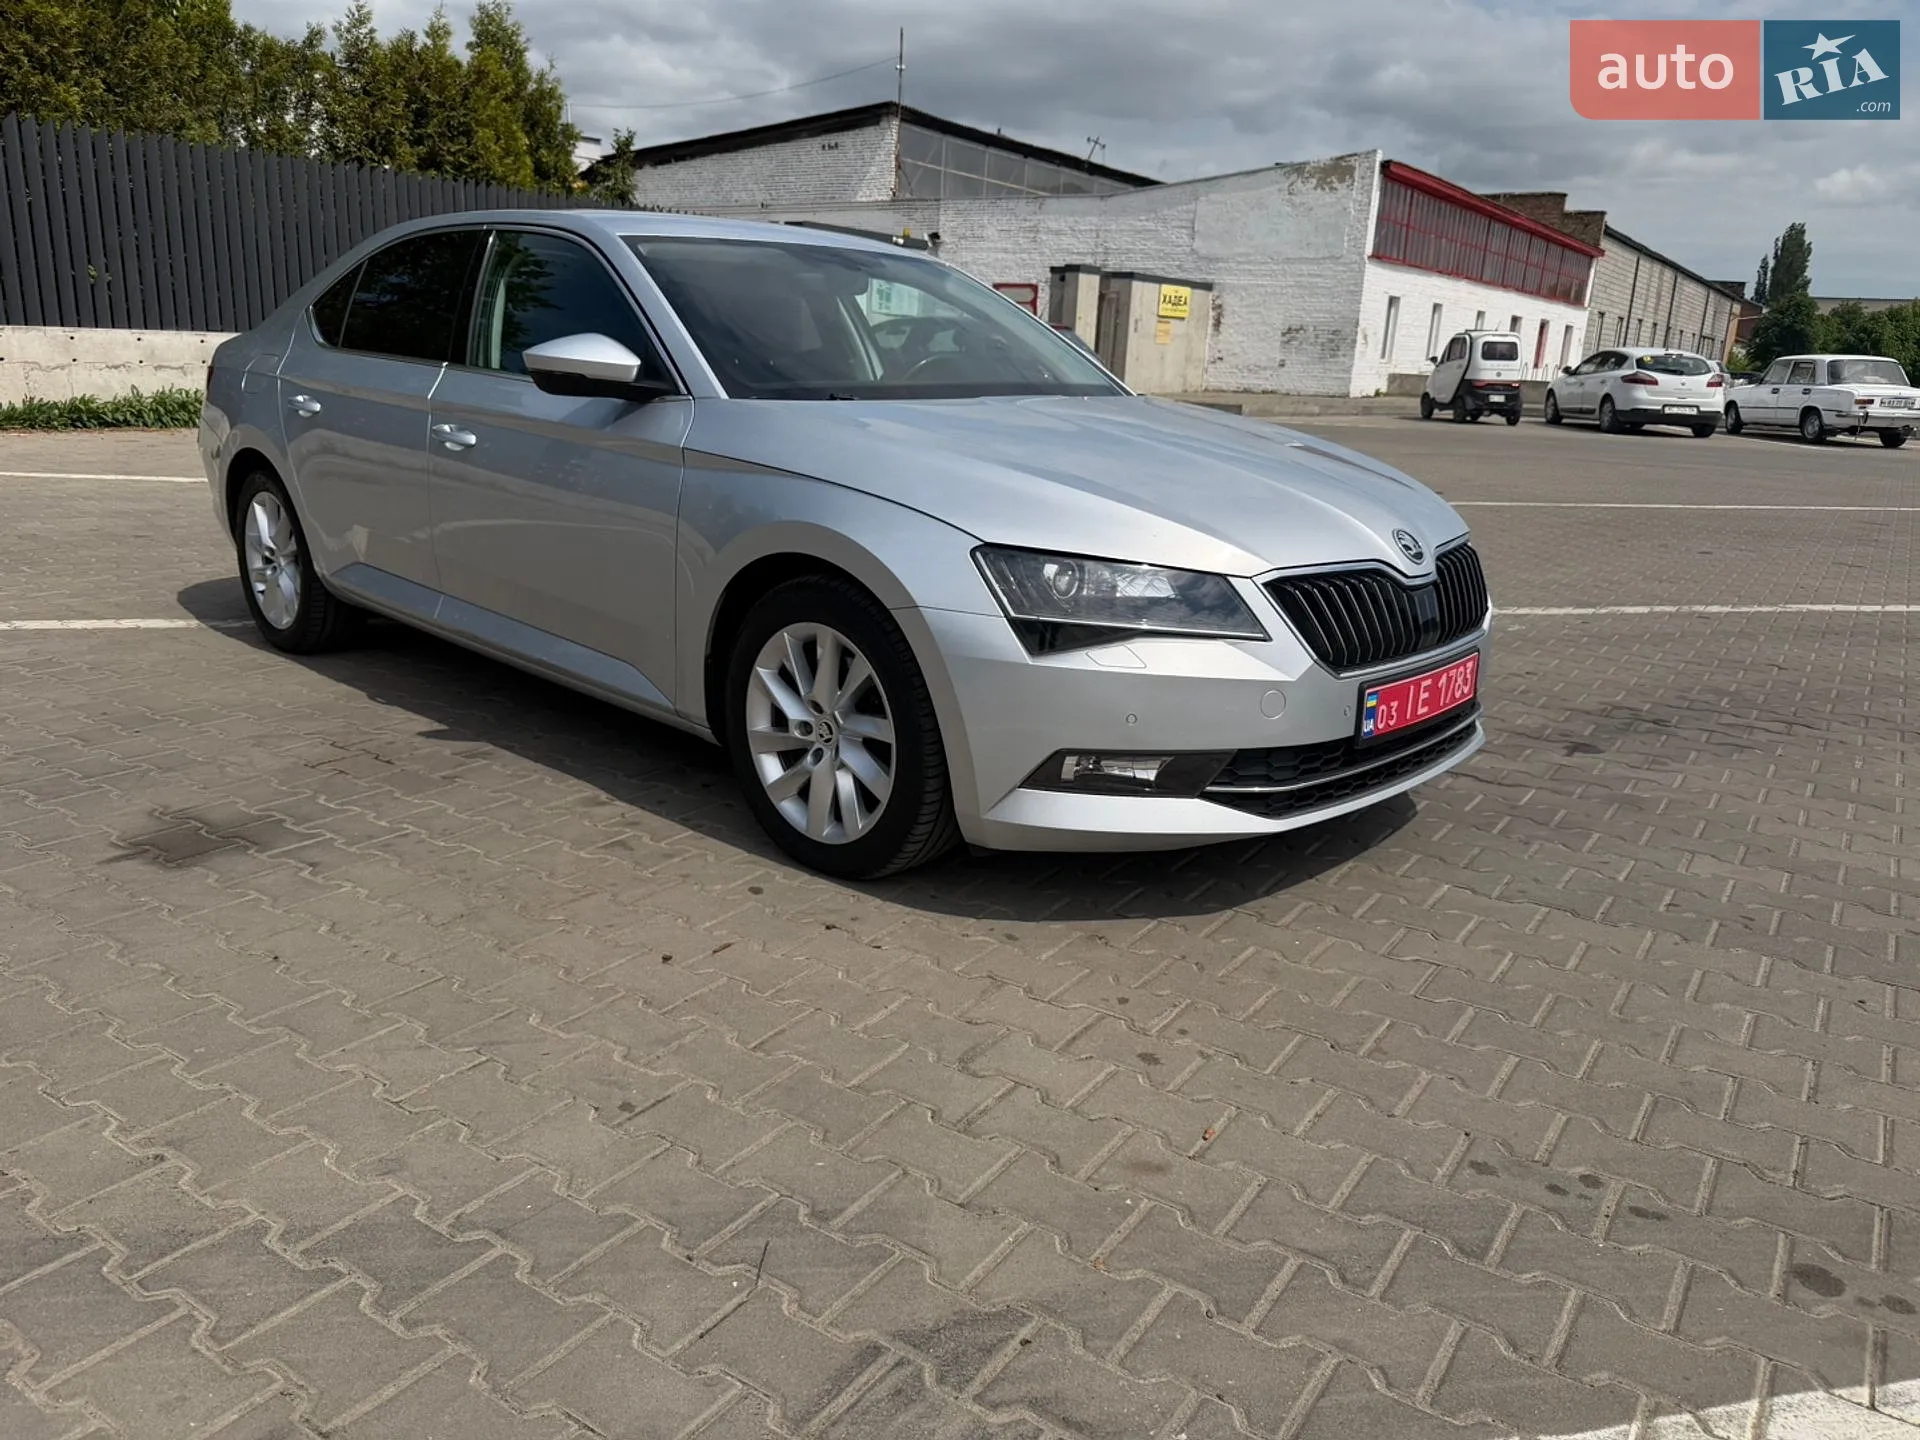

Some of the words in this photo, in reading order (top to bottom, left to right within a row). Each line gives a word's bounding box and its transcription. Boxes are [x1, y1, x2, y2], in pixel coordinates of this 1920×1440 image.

[1377, 701, 1399, 729] 03
[1406, 679, 1432, 720] IE
[1438, 661, 1474, 707] 1783
